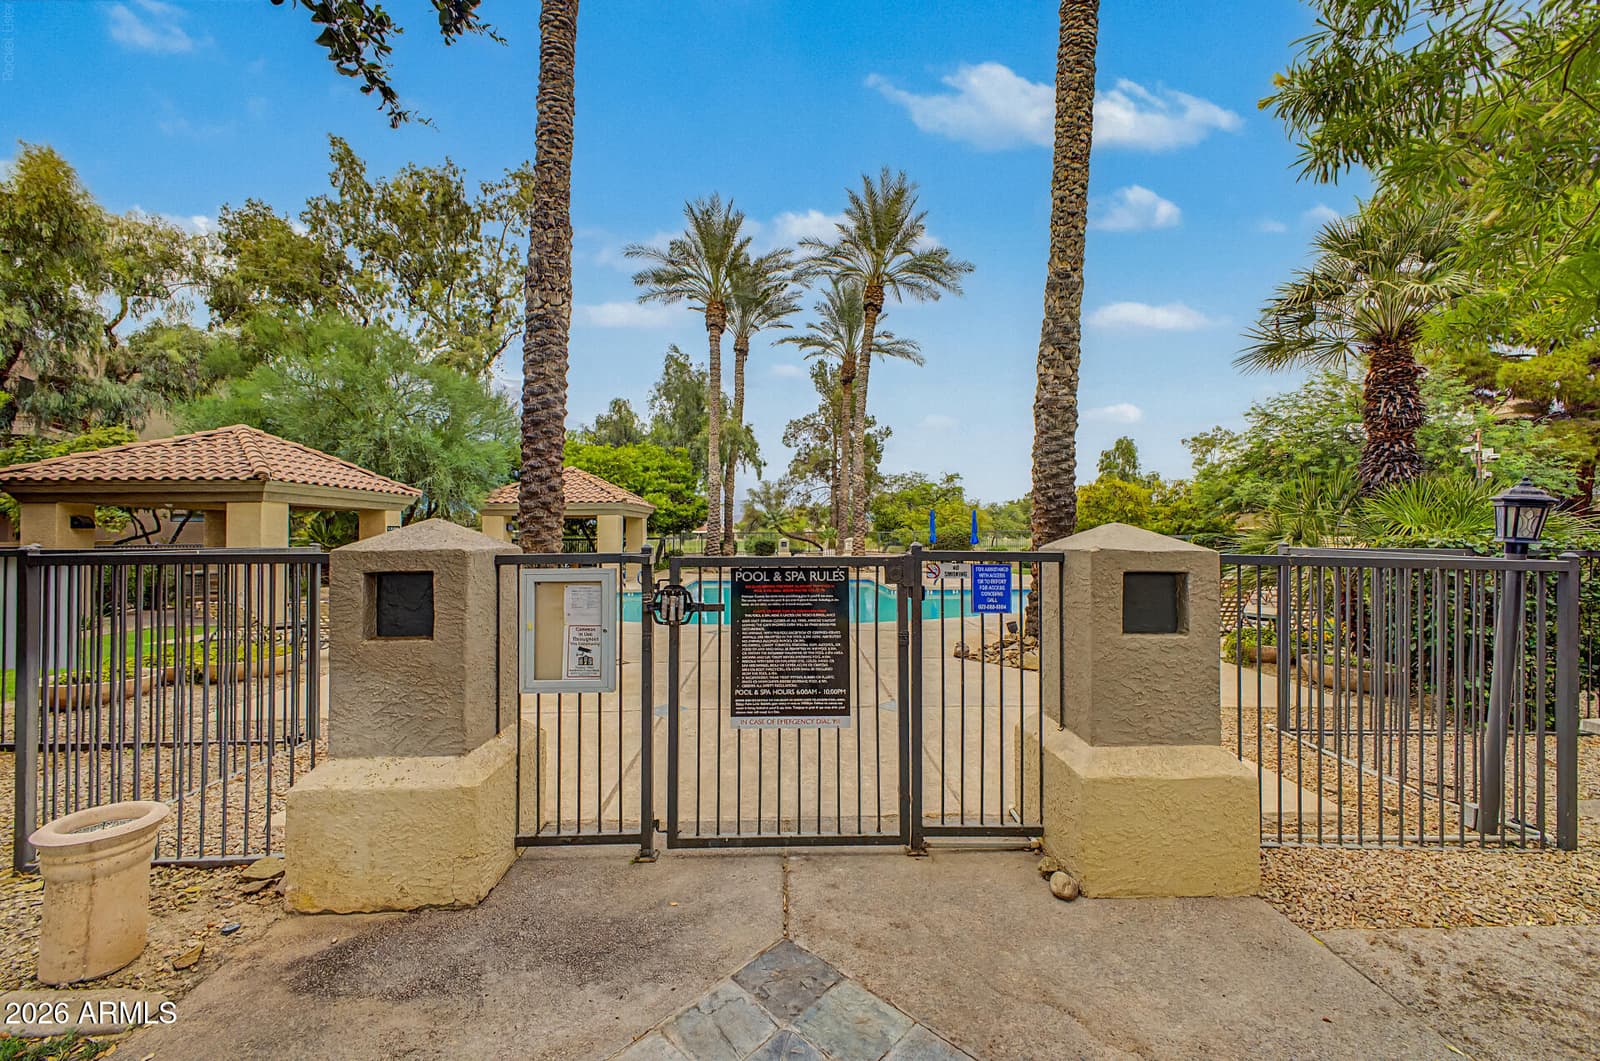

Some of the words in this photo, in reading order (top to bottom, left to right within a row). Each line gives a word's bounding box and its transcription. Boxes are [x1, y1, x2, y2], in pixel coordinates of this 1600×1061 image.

[735, 571, 769, 582] POOL
[773, 571, 782, 582] &
[785, 571, 806, 582] SPA
[809, 571, 845, 582] RULES
